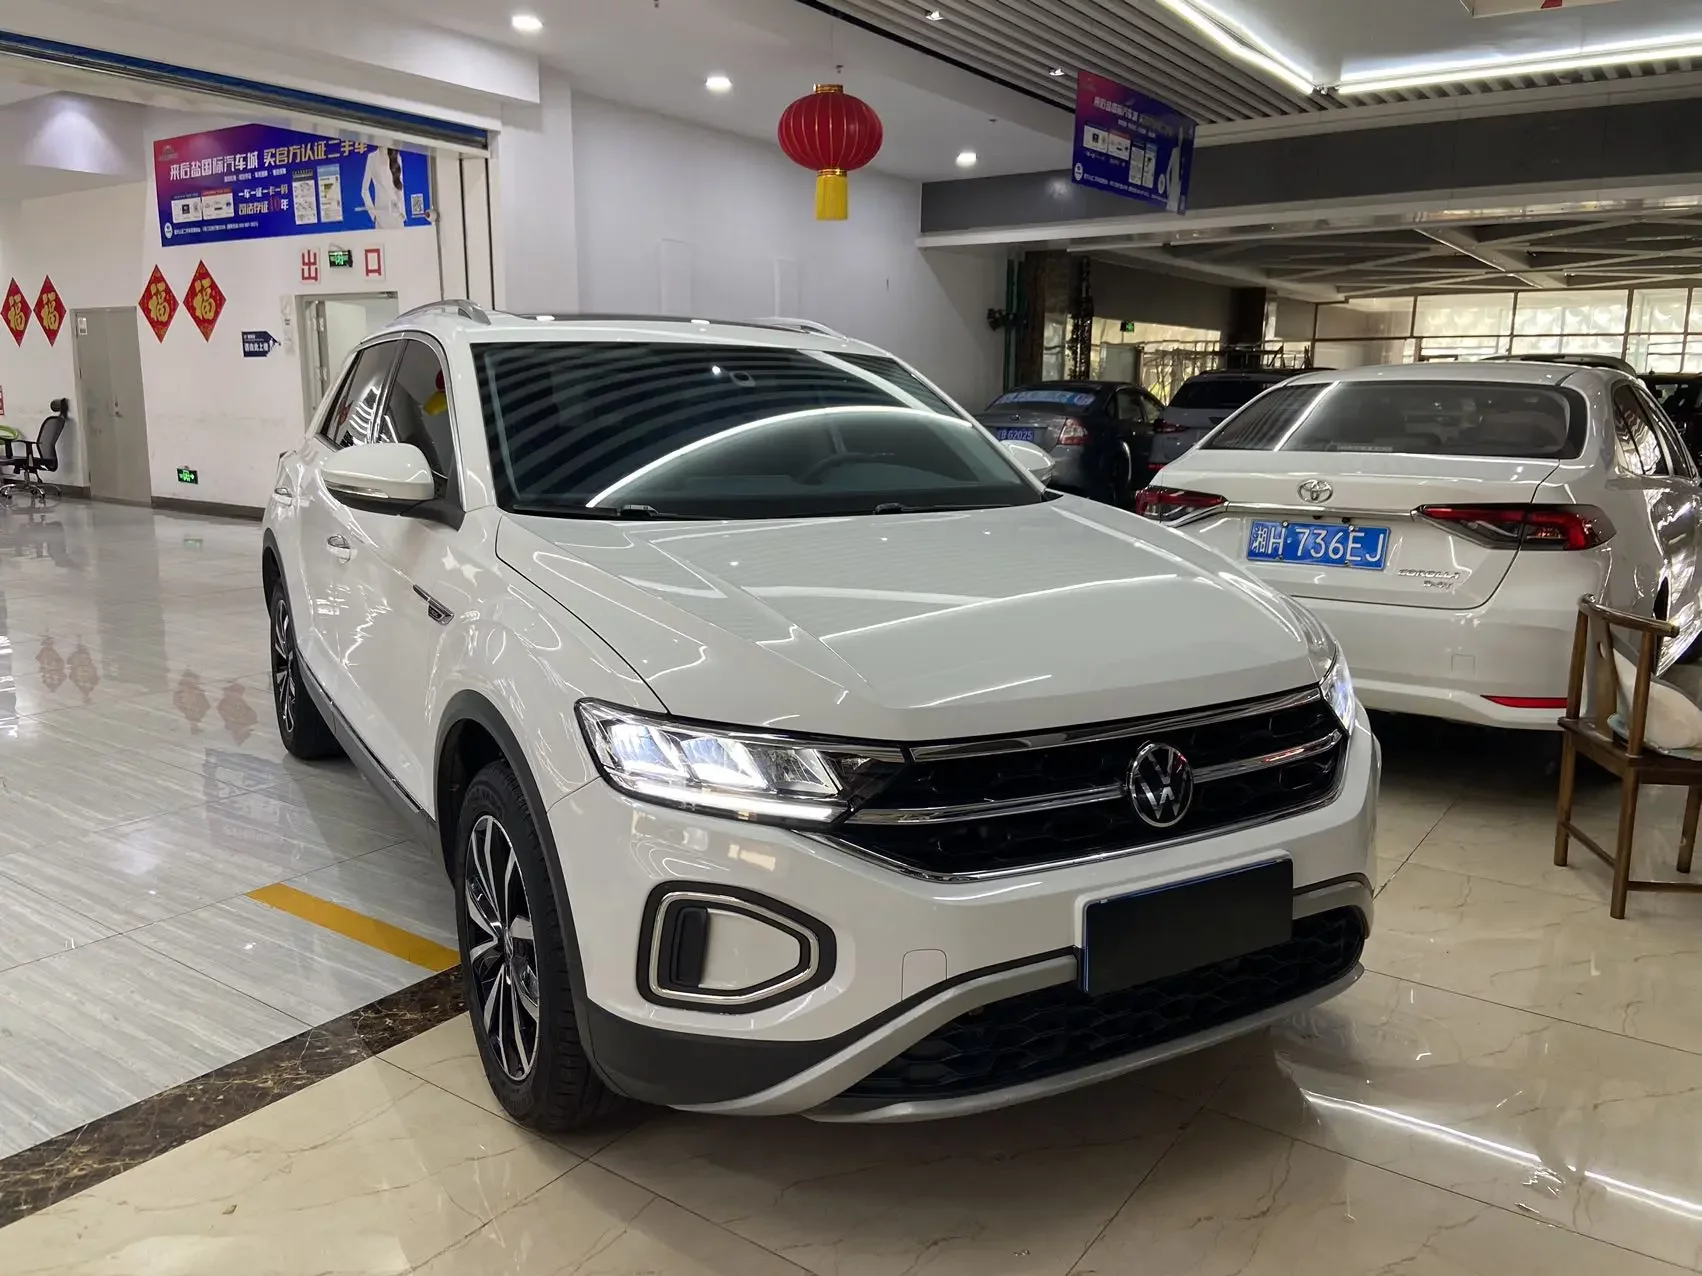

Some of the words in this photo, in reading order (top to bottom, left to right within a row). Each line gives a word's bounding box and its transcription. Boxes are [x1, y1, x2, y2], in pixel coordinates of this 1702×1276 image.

[170, 151, 259, 181] 来后盐国际汽车城
[263, 139, 369, 168] 买官方认证二手车
[301, 249, 318, 281] 出
[364, 248, 382, 276] 口
[8, 293, 26, 331] 福
[41, 291, 60, 330] 福
[148, 281, 170, 322] 福
[193, 278, 216, 320] 福
